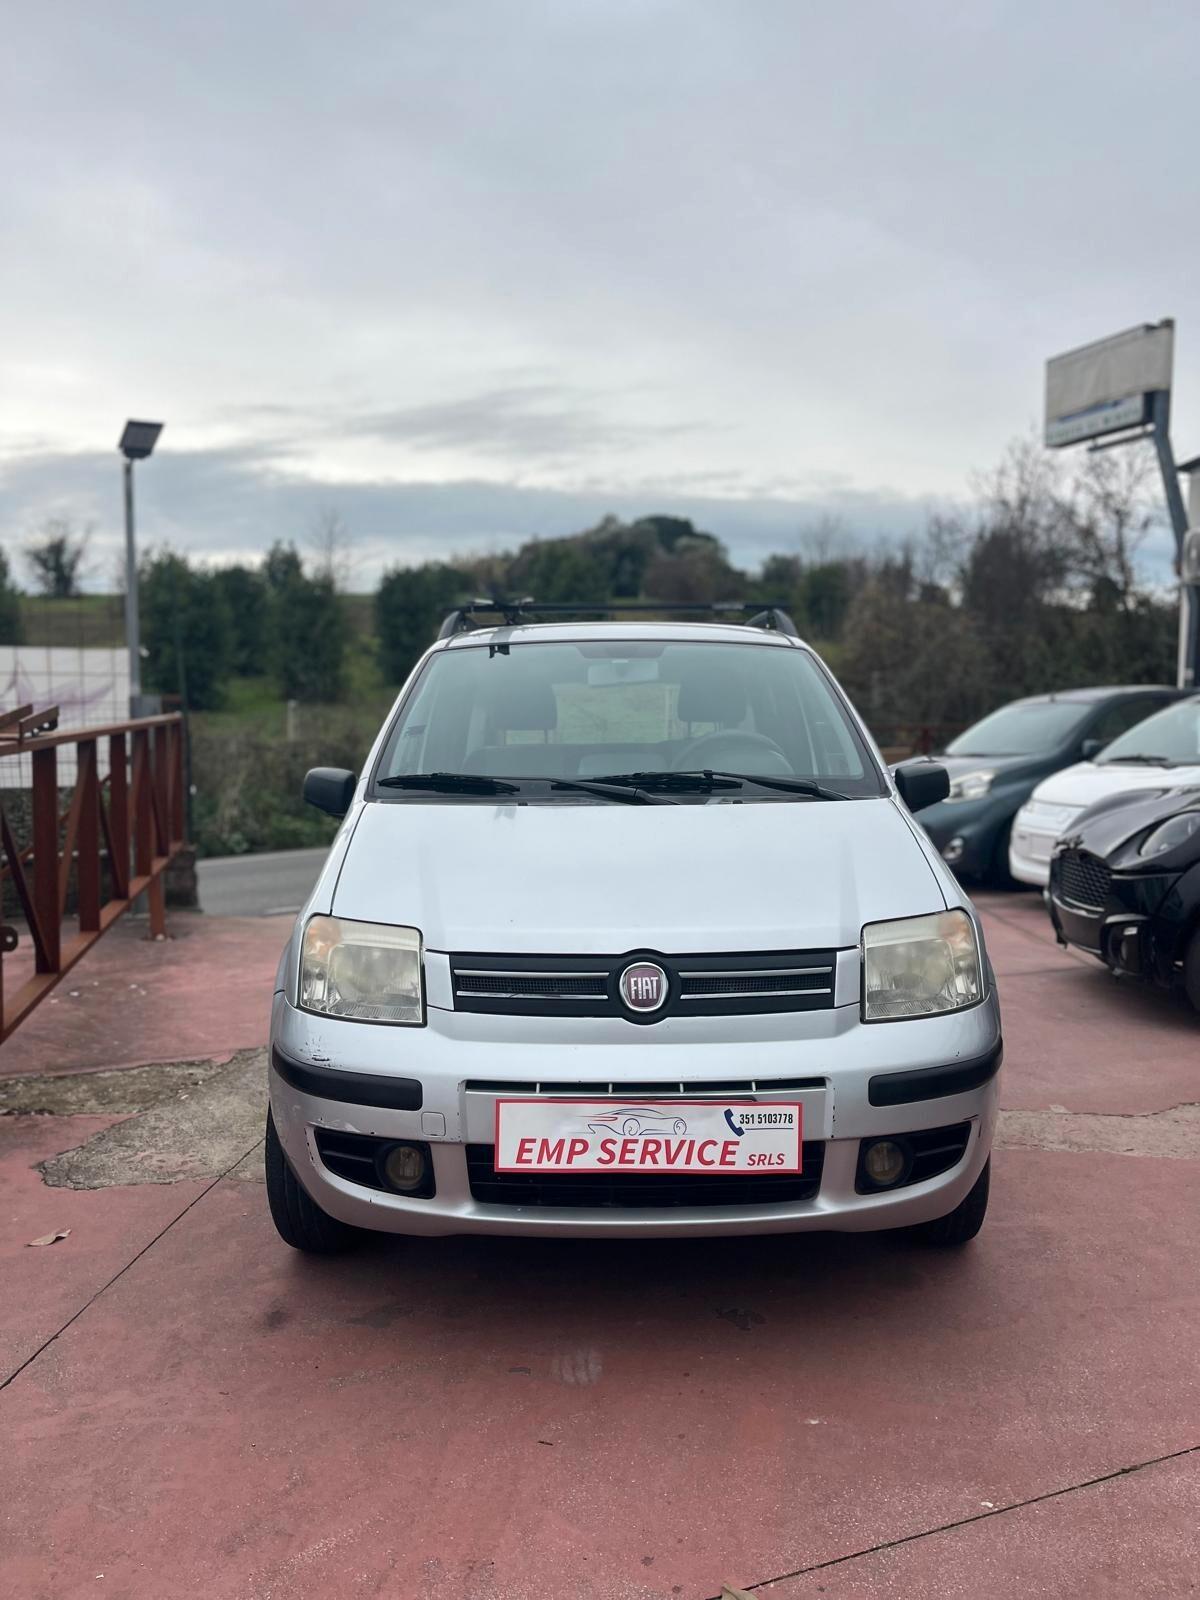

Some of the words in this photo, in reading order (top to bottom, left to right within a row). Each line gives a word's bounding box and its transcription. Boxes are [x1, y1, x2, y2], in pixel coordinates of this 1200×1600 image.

[630, 976, 659, 1000] FIAT
[739, 1113, 755, 1125] 351
[757, 1113, 794, 1125] 5103778
[515, 1138, 590, 1165] EMP
[596, 1138, 740, 1166] SERVICE
[747, 1153, 785, 1166] SRLS
